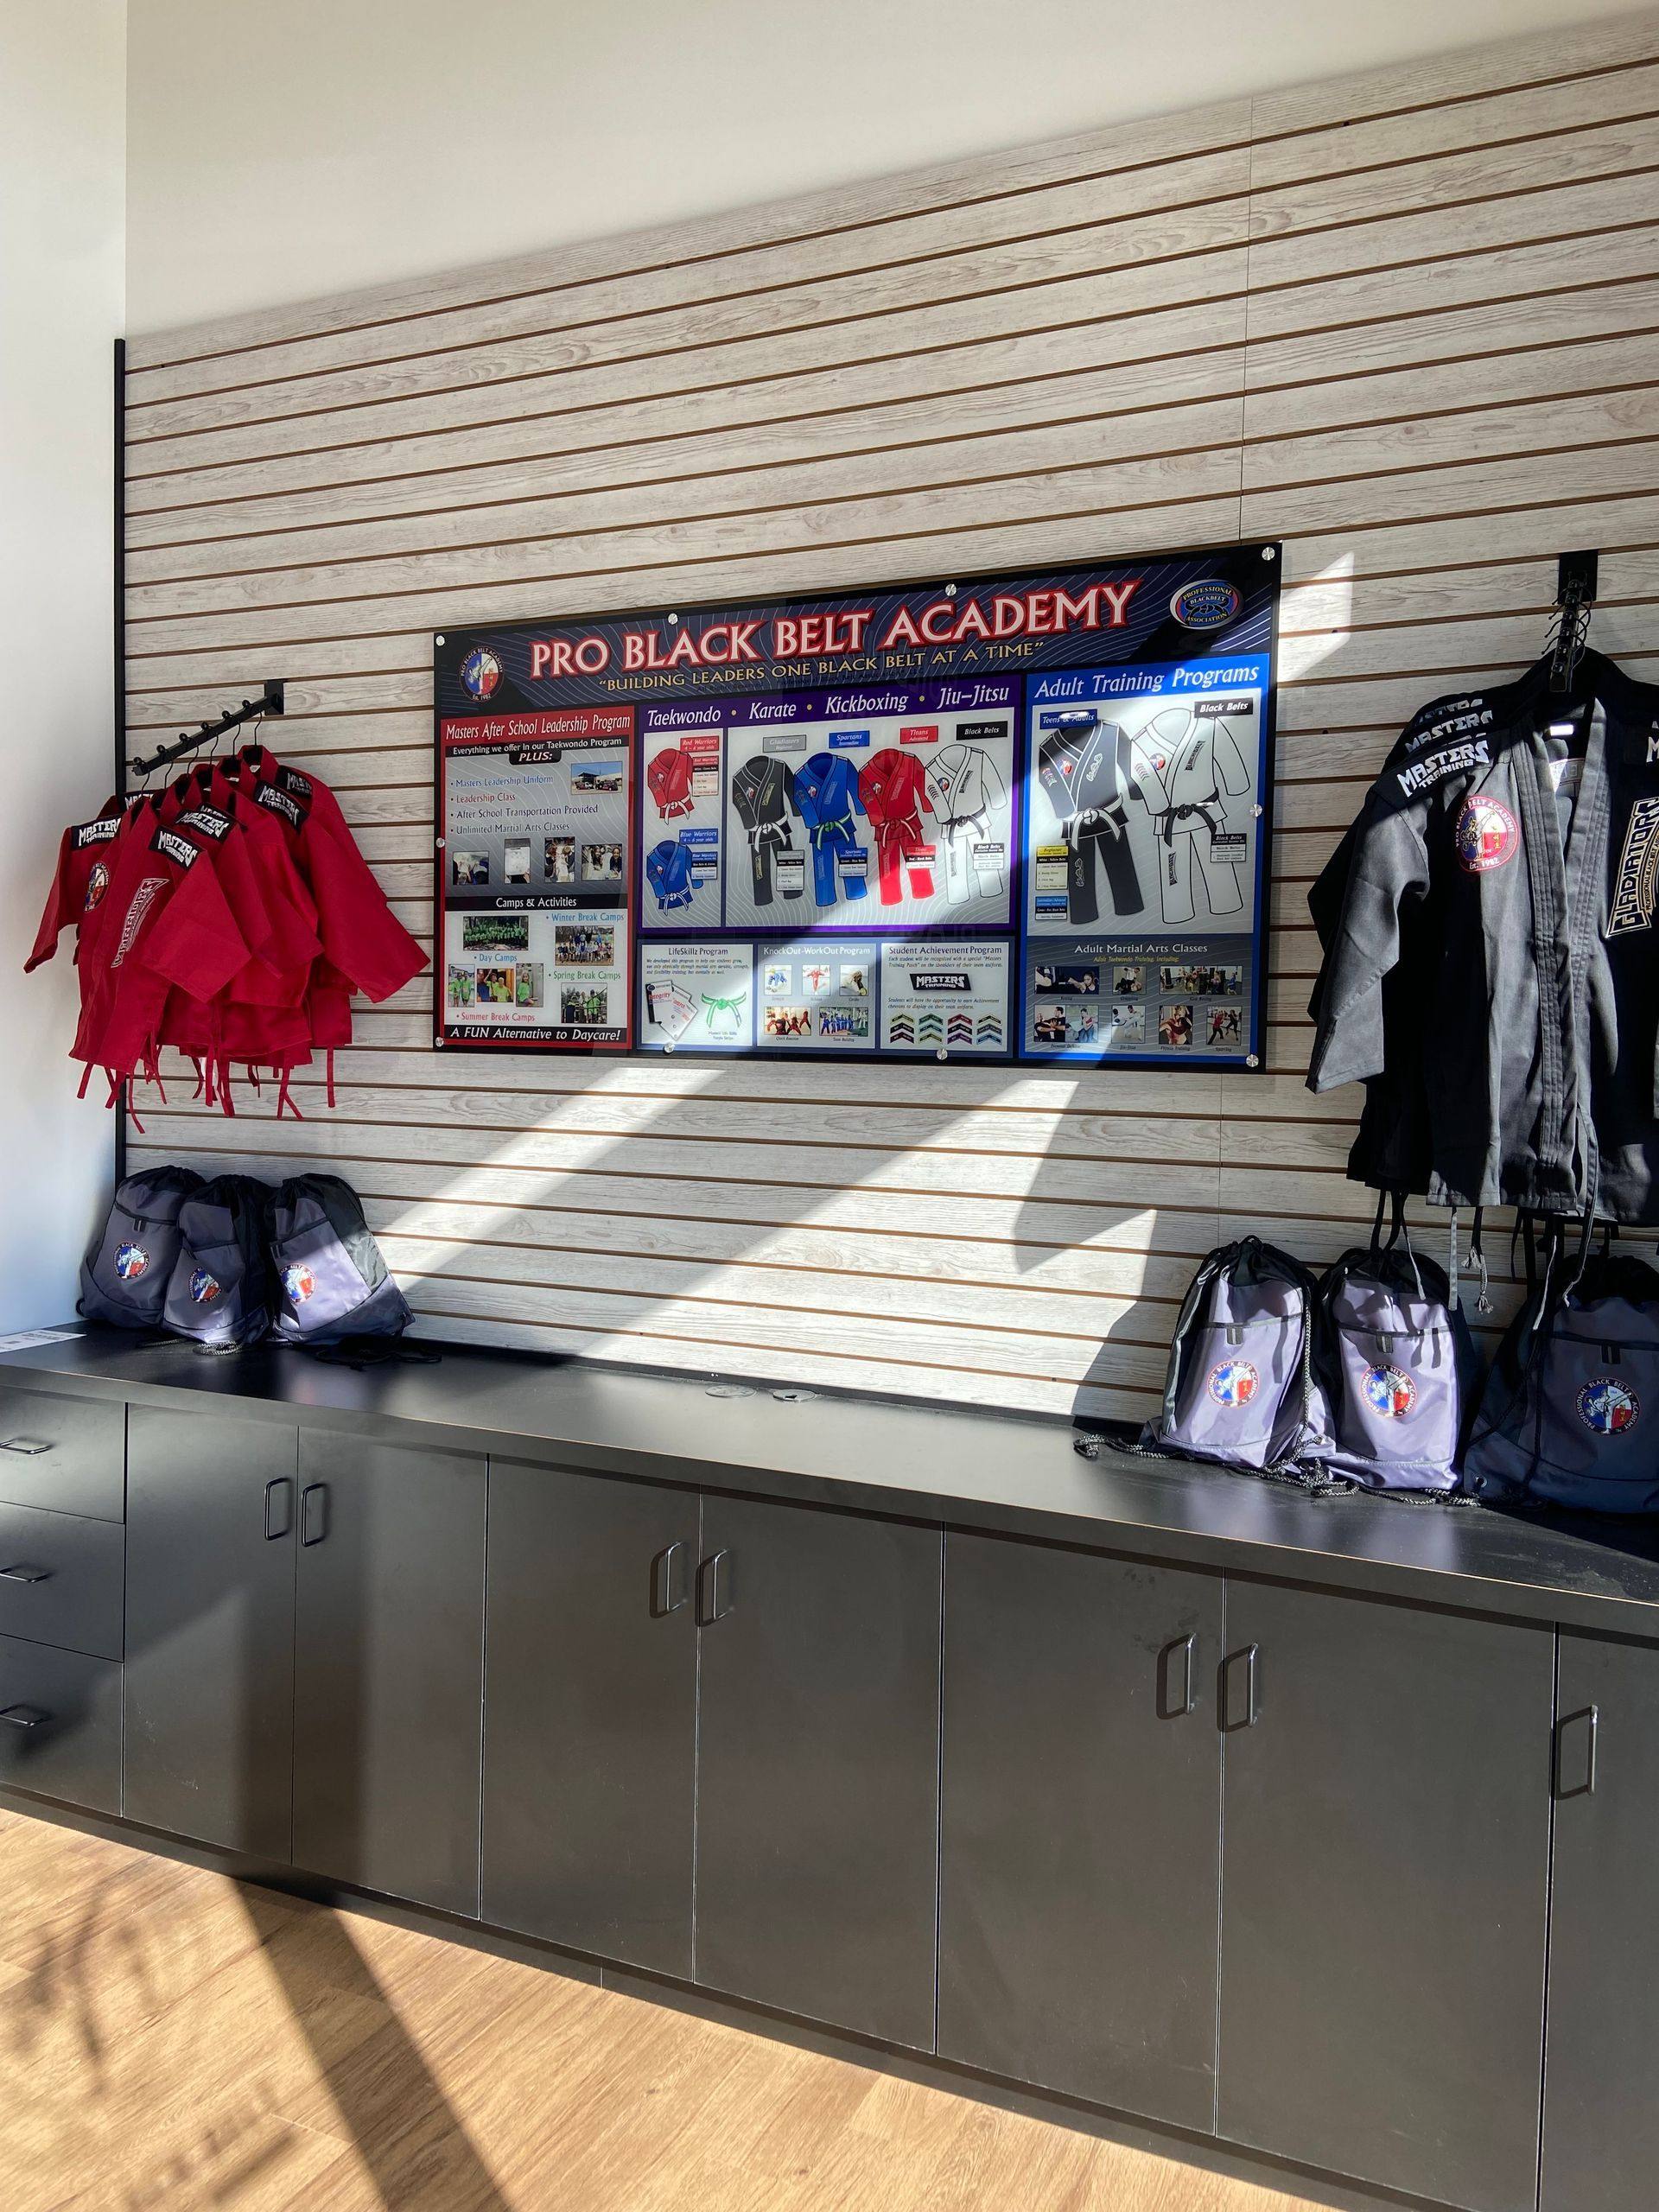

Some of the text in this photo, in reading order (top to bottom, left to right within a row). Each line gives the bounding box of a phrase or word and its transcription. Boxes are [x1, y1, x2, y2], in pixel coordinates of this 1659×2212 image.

[1183, 586, 1233, 601] PROFESSIONAL
[1186, 612, 1227, 623] ASSOCIATION
[531, 580, 1142, 680] PRO BLACK BELT ACADEMY
[693, 667, 765, 684] LEADERS
[772, 663, 810, 677] ONE
[819, 657, 877, 674] BLACK
[886, 652, 925, 668] BELT
[931, 651, 957, 664] AT
[963, 650, 978, 661] A
[1035, 666, 1260, 698] Adult Training Programs
[648, 706, 721, 726] Taekwondo
[749, 702, 797, 719] Karate
[825, 693, 908, 714] Kickboxing
[1199, 702, 1249, 713] Black Belts
[446, 715, 630, 740] Masters After School Leadership Program
[453, 744, 490, 755] Everything
[504, 743, 520, 752] offer
[547, 740, 588, 749] Taekwondo
[590, 738, 621, 747] Program
[518, 752, 552, 762] PLUS:
[1396, 740, 1490, 798] MASTERS
[1419, 760, 1474, 788] TRAINING
[485, 778, 521, 787] Leadership
[456, 795, 494, 804] Leadership
[479, 808, 502, 817] School
[505, 806, 562, 817] Transportation
[564, 804, 598, 814] Provided
[1456, 806, 1468, 829] BLACK
[1468, 799, 1486, 808] BELT
[1488, 800, 1515, 832] ACADEMY
[175, 812, 230, 837] MASTERS
[456, 825, 493, 835] Unlimited
[495, 824, 522, 833] Martial
[525, 823, 541, 831] Arts
[158, 831, 198, 867] MASTERS
[496, 897, 576, 908] Camps & Activities
[601, 913, 624, 922] Camps
[840, 947, 870, 956] Program
[970, 946, 1001, 955] Program
[1075, 944, 1103, 953] Adult
[1107, 944, 1142, 953] Martial
[480, 954, 493, 963] Day
[553, 971, 575, 980] Spring
[598, 971, 620, 980] Camps
[916, 976, 964, 988] MASTERS
[450, 1027, 620, 1041] A FUN Alternative to Daycare!
[1576, 1379, 1638, 1430] PROFESSIONAL BLACK BELT ACADEMY
